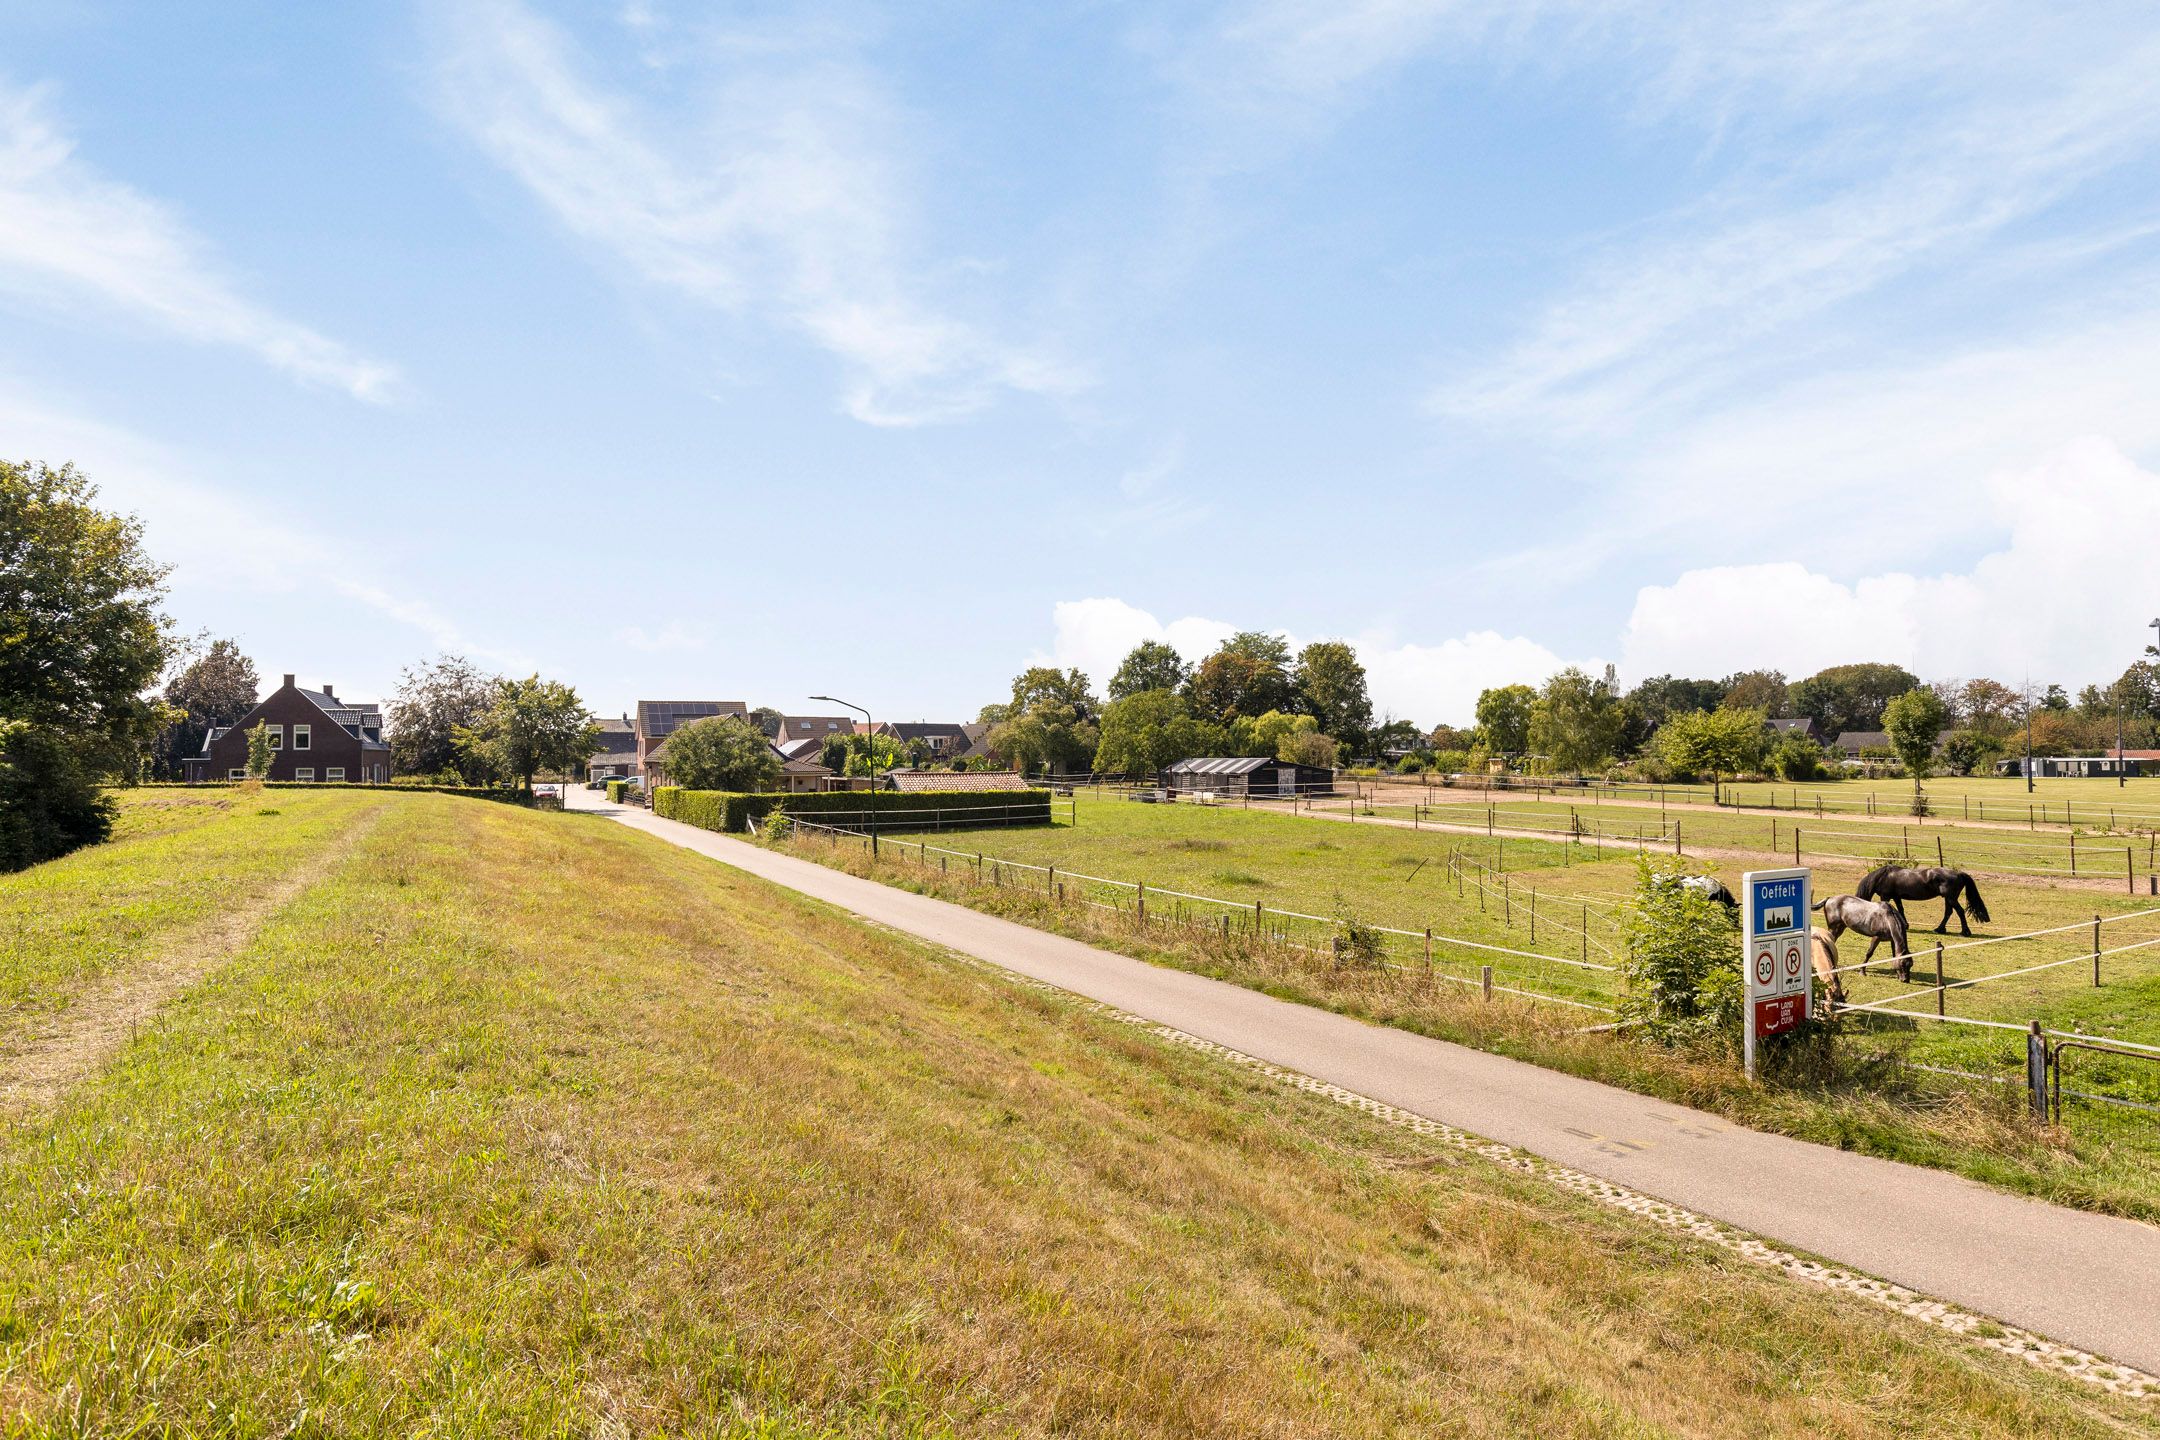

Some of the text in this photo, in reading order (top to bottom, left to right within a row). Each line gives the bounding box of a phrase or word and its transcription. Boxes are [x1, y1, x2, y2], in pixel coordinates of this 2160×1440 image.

[1761, 884, 1796, 899] Oeffelt
[1760, 962, 1771, 975] 30
[1780, 1001, 1794, 1010] LAND
